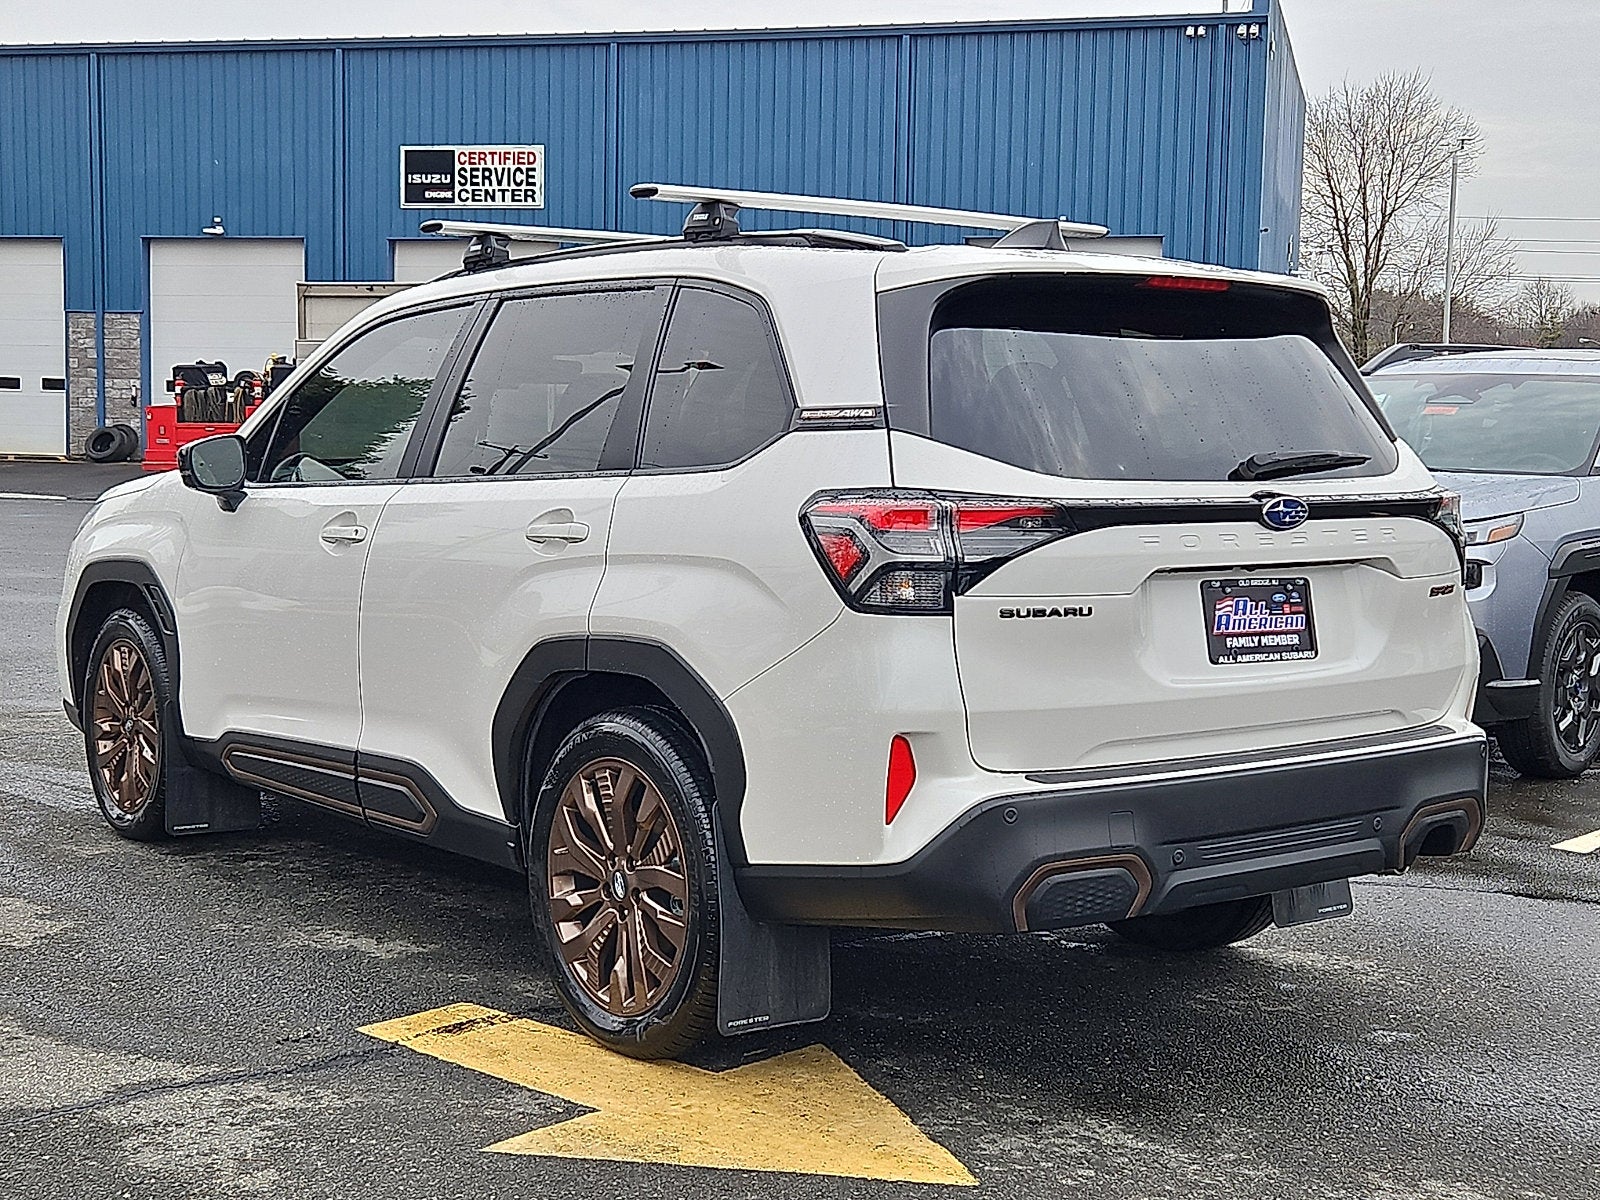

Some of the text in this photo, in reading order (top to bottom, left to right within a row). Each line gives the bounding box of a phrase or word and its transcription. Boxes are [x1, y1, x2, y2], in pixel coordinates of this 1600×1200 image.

[457, 151, 537, 165] CERTIFIED
[407, 174, 450, 184] ISUZU
[457, 167, 537, 187] SERVICE
[457, 188, 537, 203] CENTER
[1138, 527, 1397, 550] FORESTER
[999, 607, 1093, 618] SUBARU
[1226, 634, 1300, 648] FAMILY MEMBER
[1218, 650, 1316, 664] ALL AMERICAN SUBARU
[727, 1015, 770, 1028] FORESTER
